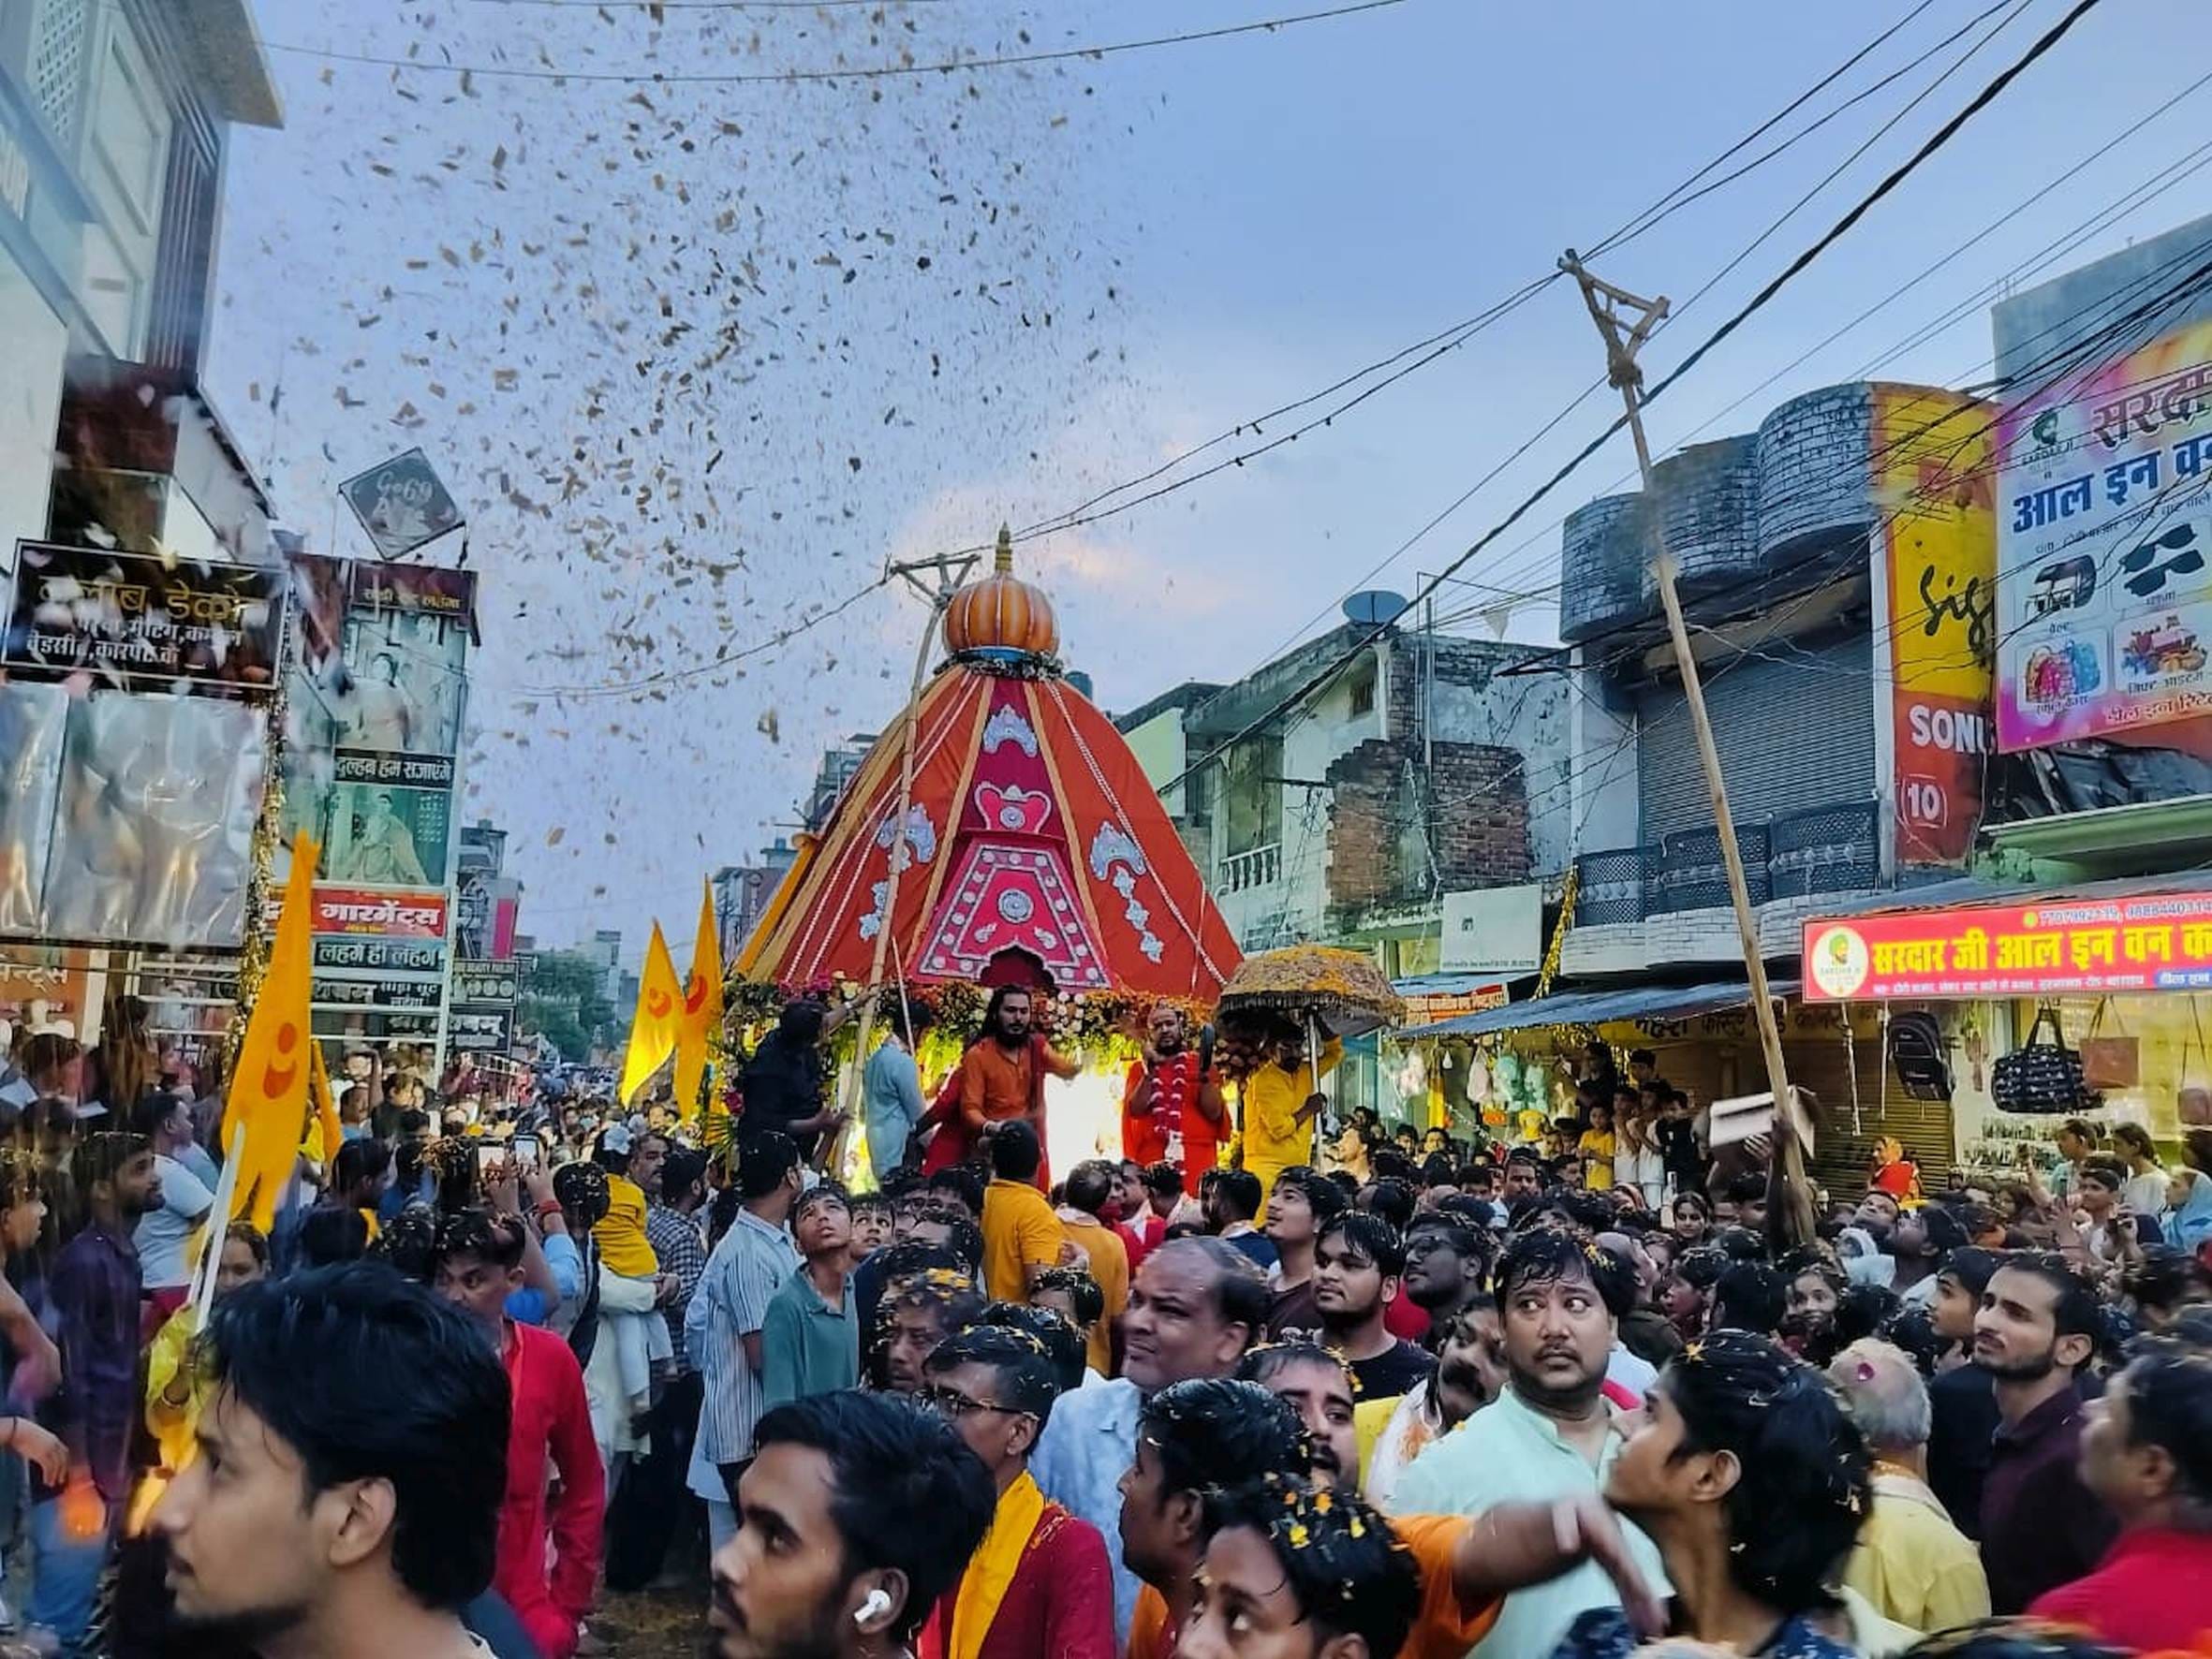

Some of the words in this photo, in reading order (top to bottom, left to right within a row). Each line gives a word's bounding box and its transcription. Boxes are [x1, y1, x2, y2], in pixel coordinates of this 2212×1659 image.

[2013, 473, 2094, 533] आल
[2104, 450, 2160, 506] इन
[1907, 784, 1941, 821] 10
[1872, 939, 1948, 976] सरदार
[1952, 926, 1989, 971] जी
[1996, 932, 2063, 970] आल
[2069, 927, 2117, 971] इन
[2122, 924, 2175, 963] वन
